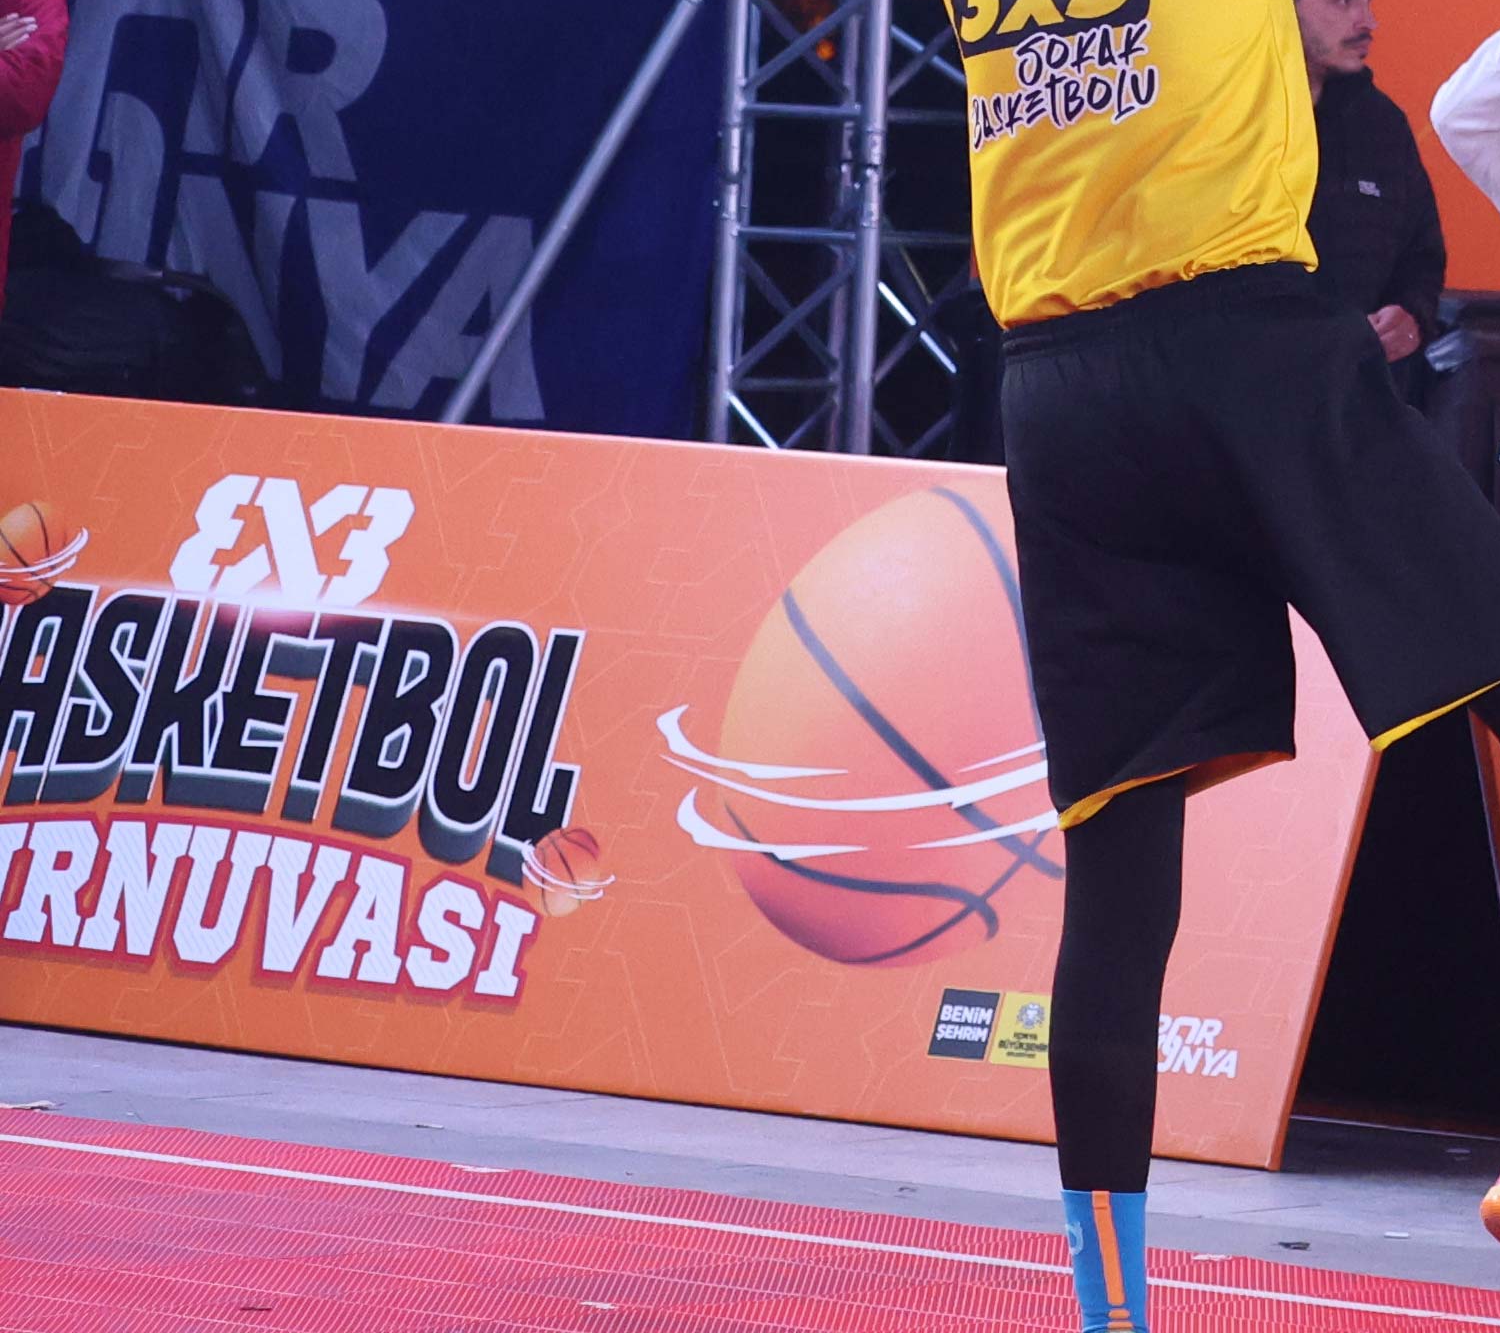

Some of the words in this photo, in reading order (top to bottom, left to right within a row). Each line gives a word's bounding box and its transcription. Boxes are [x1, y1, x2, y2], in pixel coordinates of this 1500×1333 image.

[1015, 21, 1151, 85] SOKAK
[971, 66, 1158, 153] BASKETBOLU
[0, 582, 586, 873] ASKETBOL
[0, 820, 534, 999] RNUVASI
[1157, 1039, 1239, 1079] ONYA
